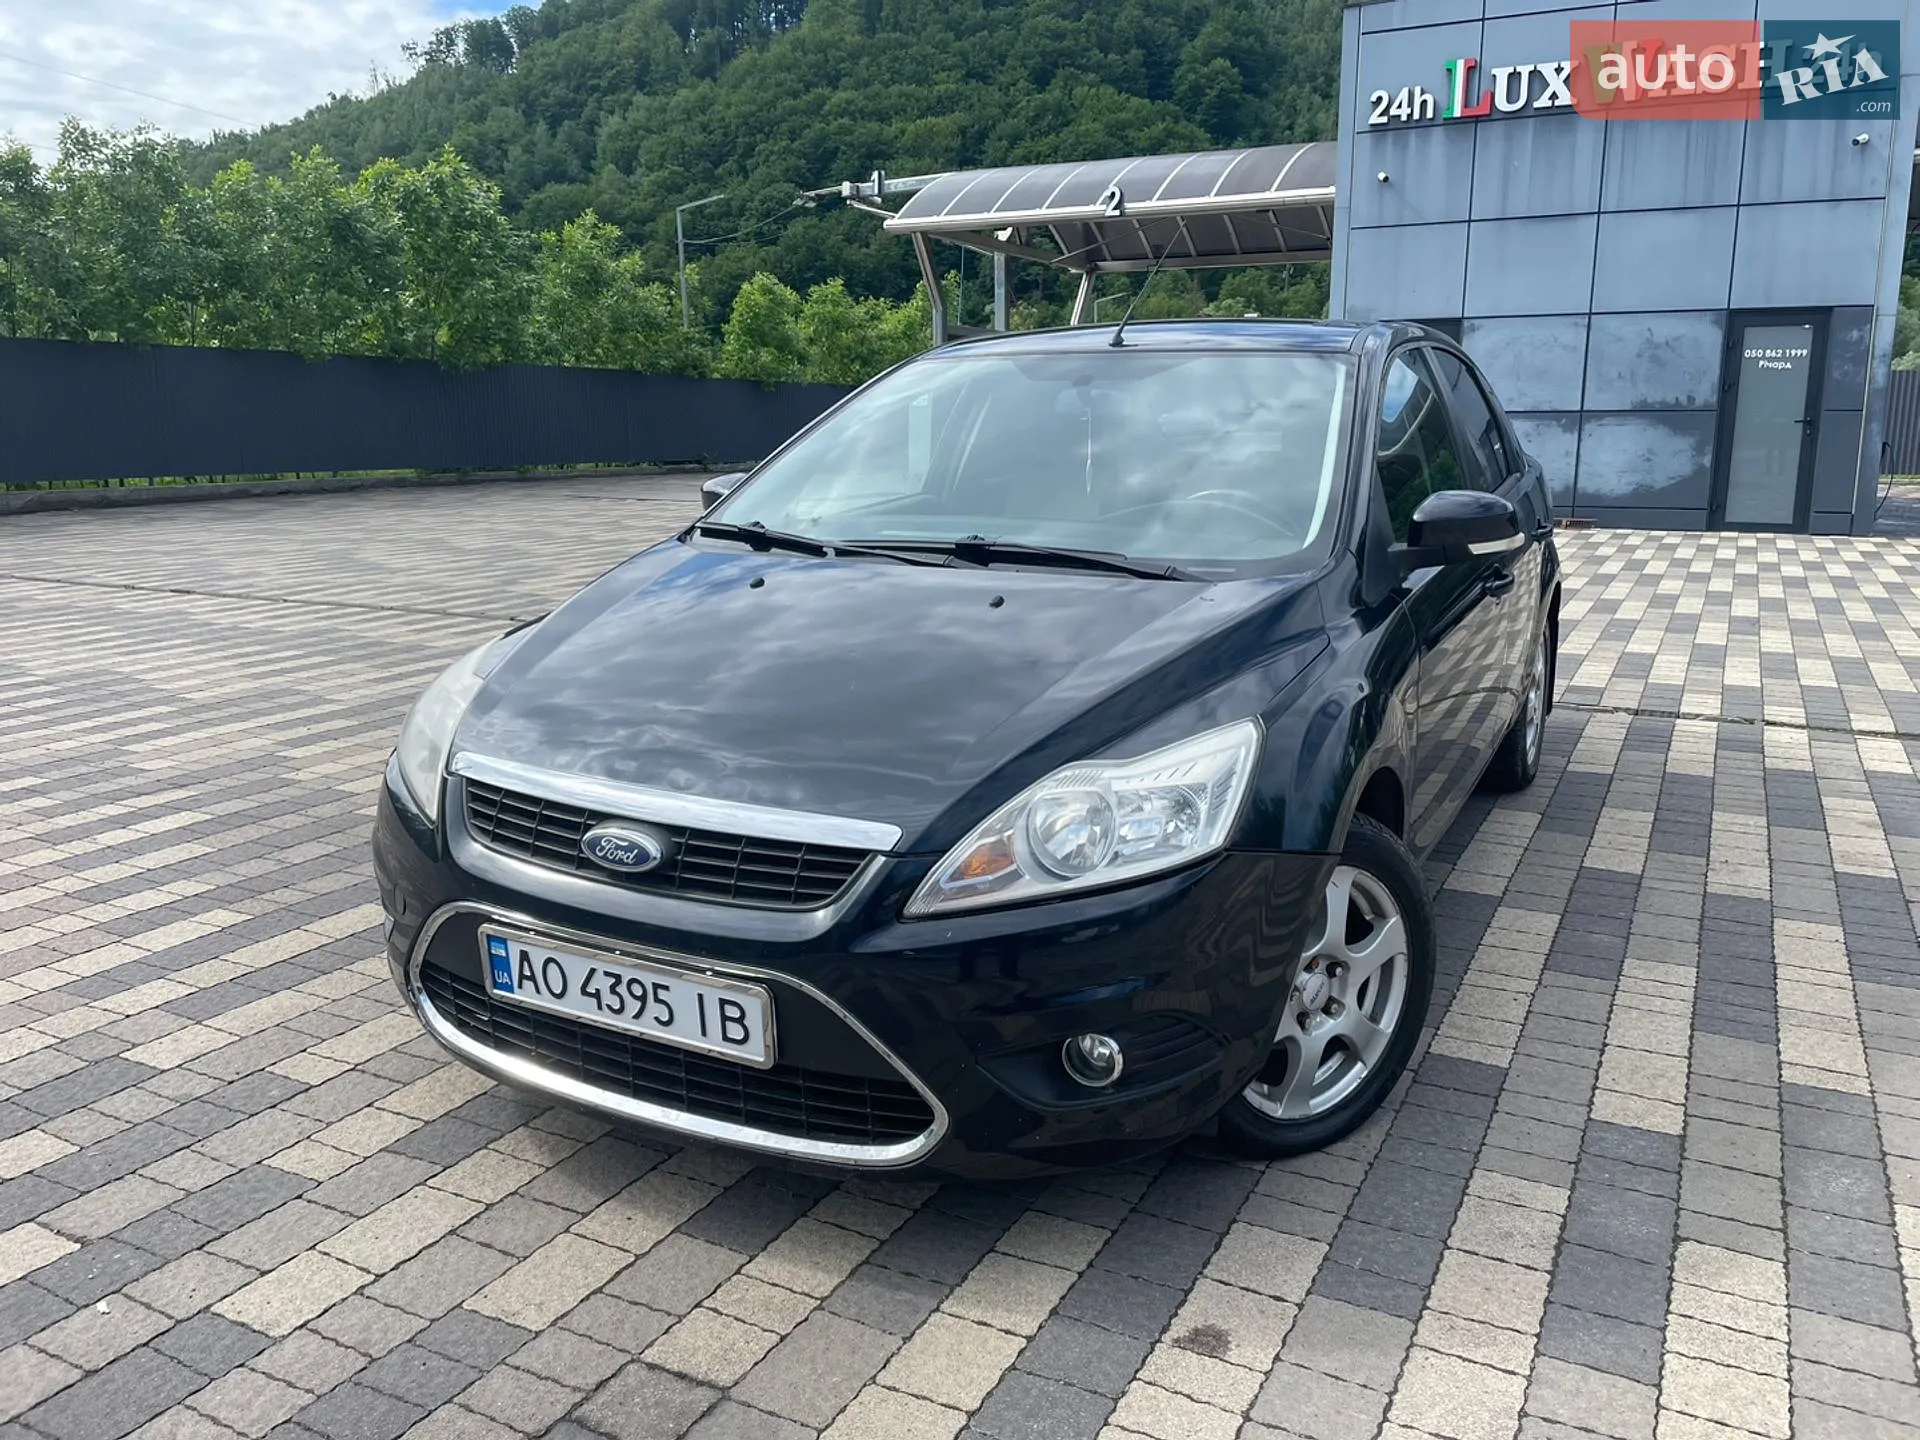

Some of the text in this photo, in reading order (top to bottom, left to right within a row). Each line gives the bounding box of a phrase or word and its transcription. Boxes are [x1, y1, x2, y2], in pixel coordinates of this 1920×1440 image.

[1368, 86, 1434, 124] 24h
[1105, 186, 1120, 215] 2
[1744, 349, 1807, 357] 050 862 1999
[596, 836, 638, 864] Ford
[494, 969, 511, 985] UA
[518, 950, 749, 1045] AO 4395 IB
